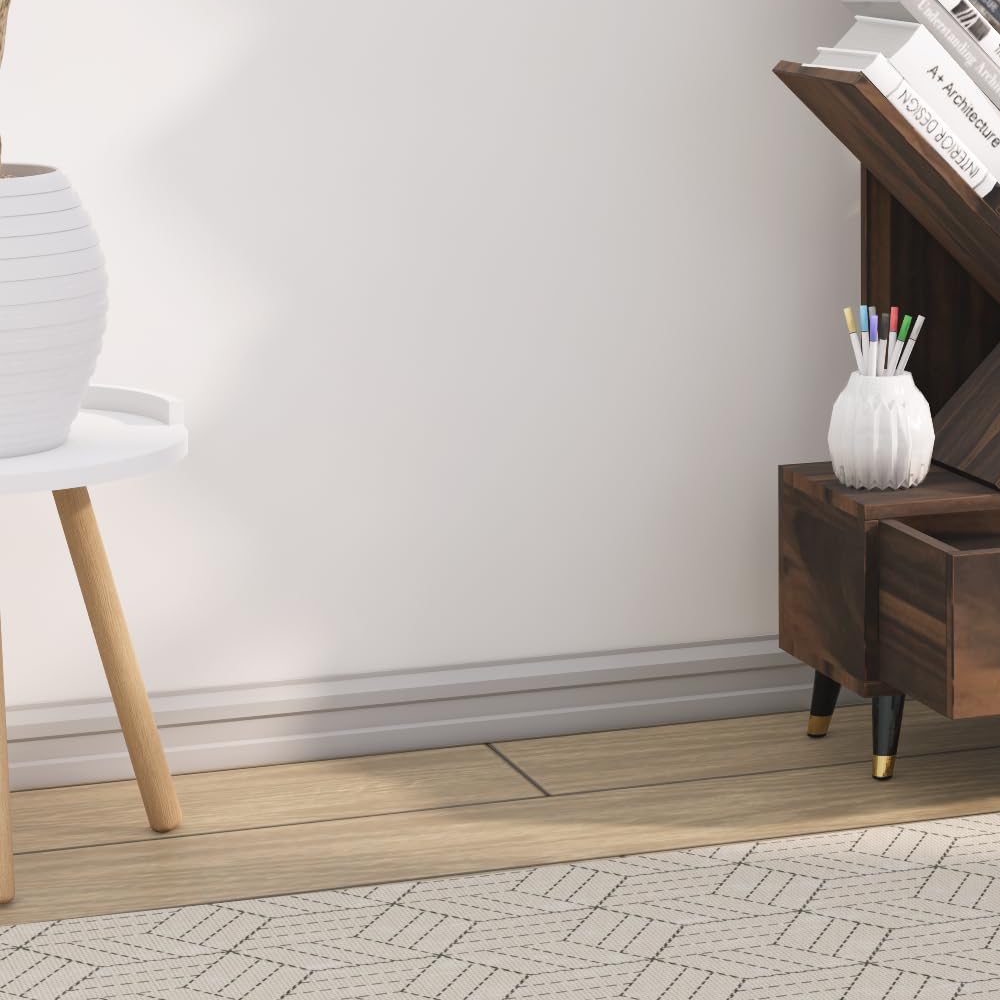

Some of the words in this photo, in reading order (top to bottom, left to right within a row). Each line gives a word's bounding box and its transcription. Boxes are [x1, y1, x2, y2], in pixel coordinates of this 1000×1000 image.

[897, 89, 939, 134] DESIGN
[927, 65, 944, 83] A+
[942, 82, 1000, 148] Architecture
[935, 129, 980, 179] INTERIOR
